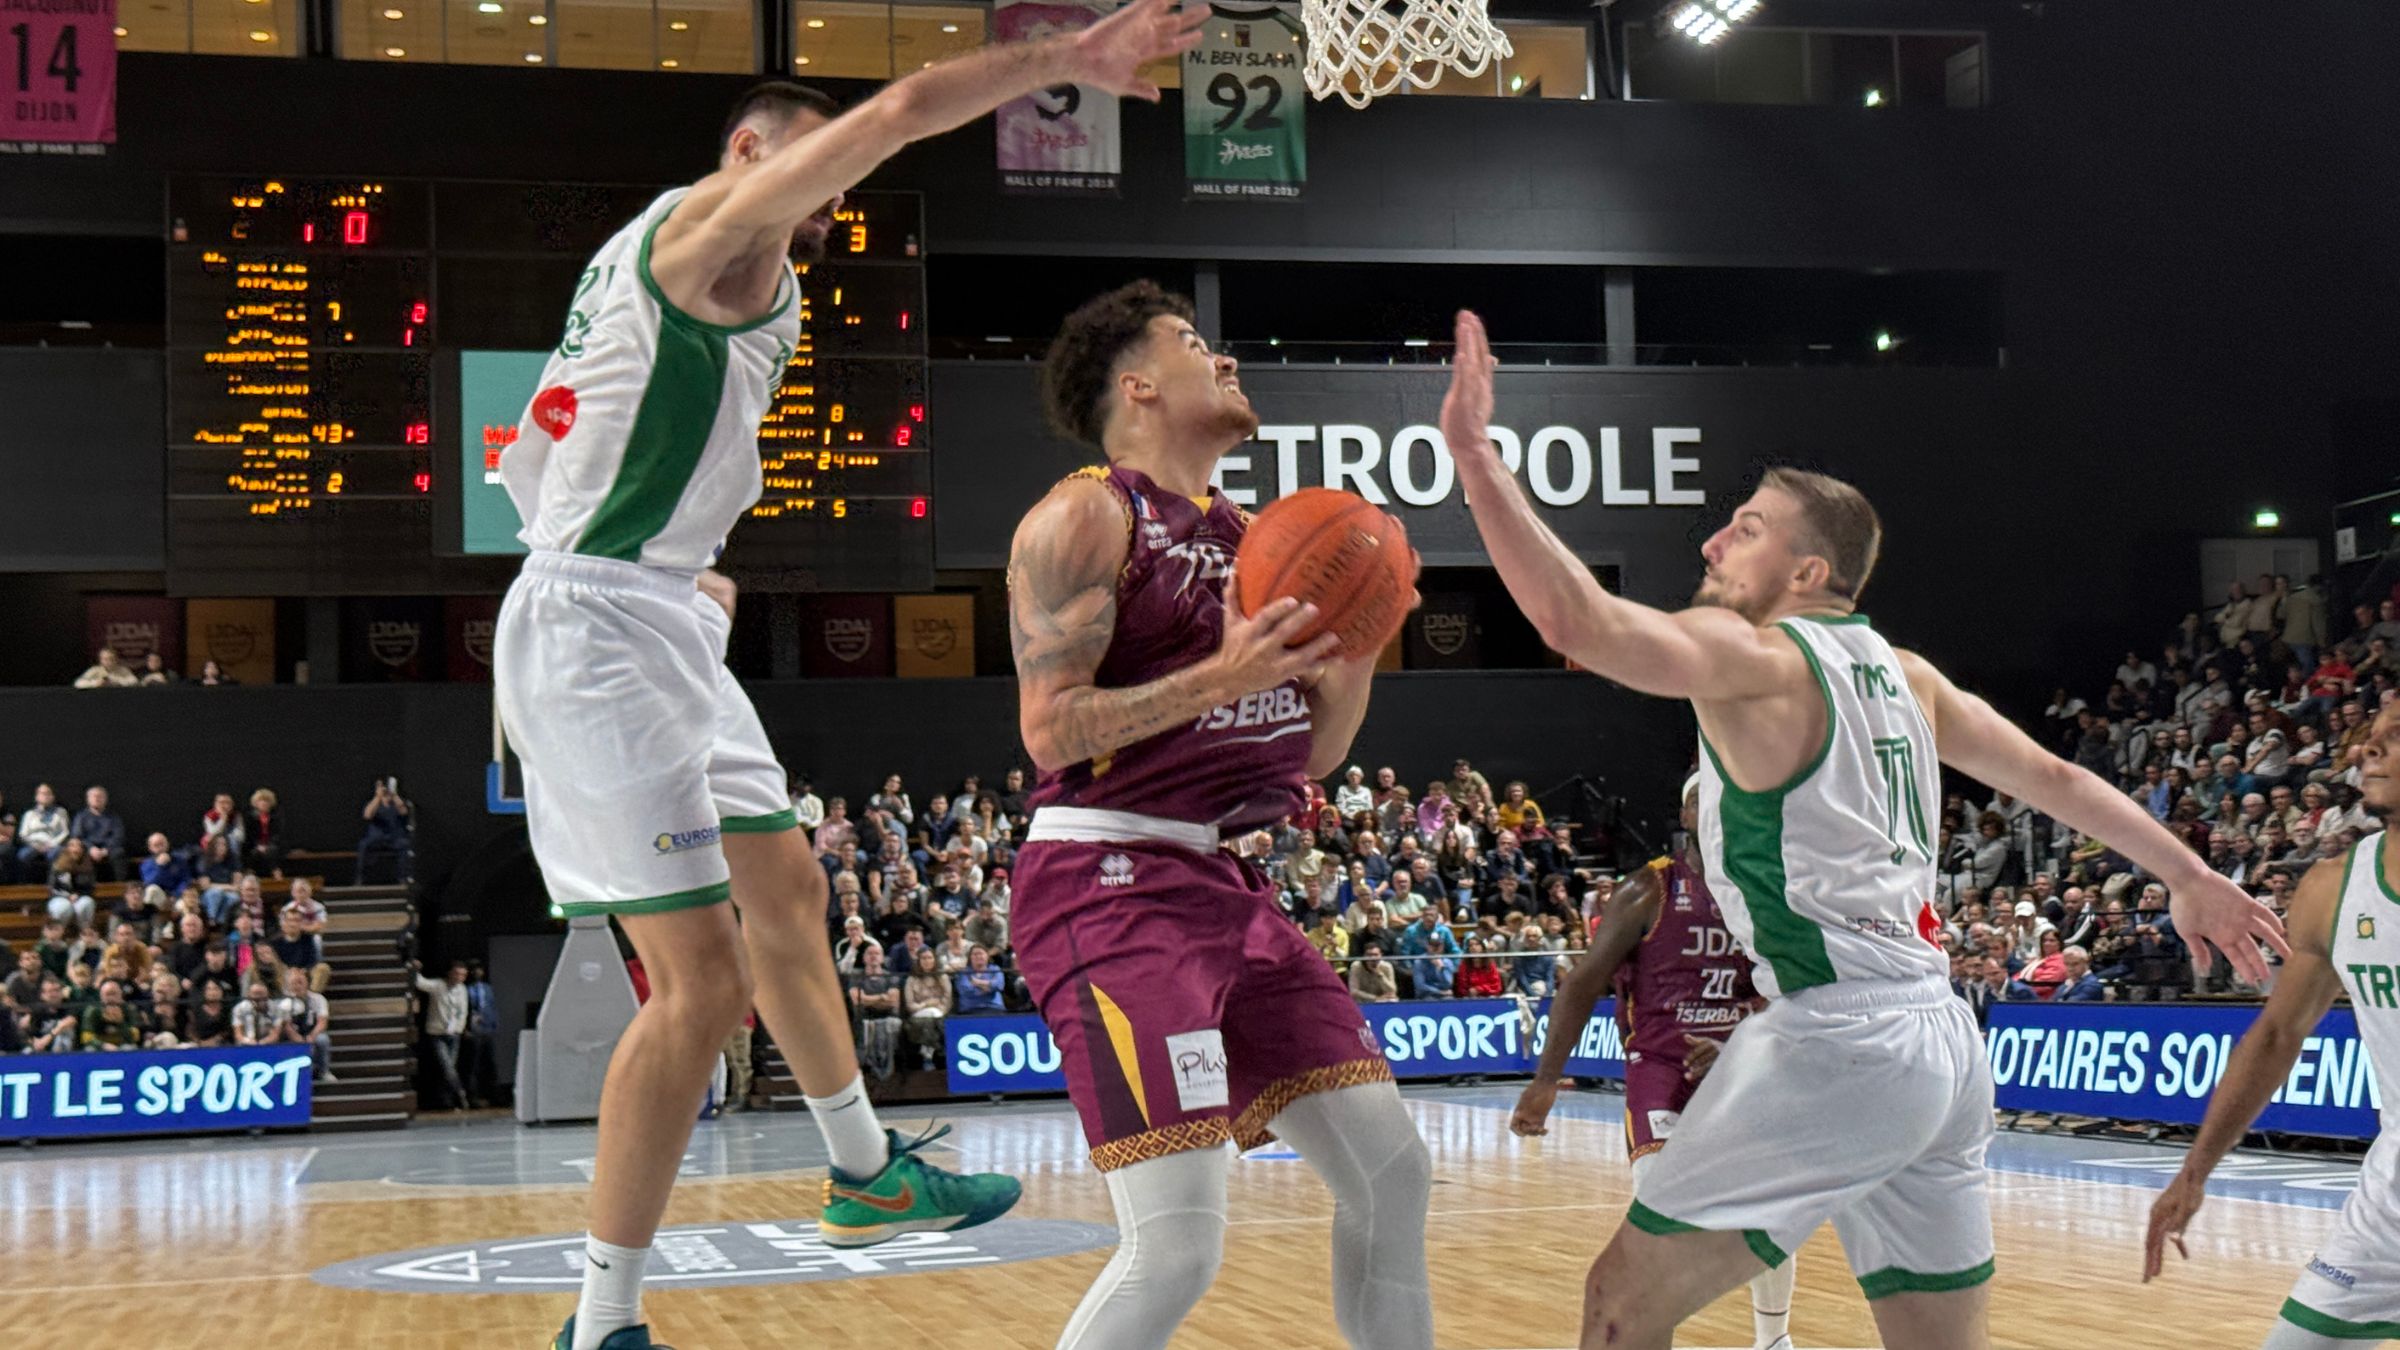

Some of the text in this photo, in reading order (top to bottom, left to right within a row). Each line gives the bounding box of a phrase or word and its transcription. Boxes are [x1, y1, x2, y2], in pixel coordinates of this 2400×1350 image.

[11, 23, 83, 92] 14
[1210, 51, 1242, 66] BEN
[15, 101, 77, 122] DIJON
[1206, 72, 1284, 133] 92
[1005, 175, 1034, 187] HALL
[1193, 184, 1223, 195] HALL
[1224, 184, 1240, 195] OF
[1241, 185, 1271, 196] FAME
[1851, 662, 1898, 699] TMC
[1681, 926, 1747, 958] JDA
[1700, 968, 1738, 1000] 20
[2346, 963, 2400, 1009] TR
[1384, 1009, 1523, 1062] SPORT
[0, 1055, 312, 1119] T LE SPORT
